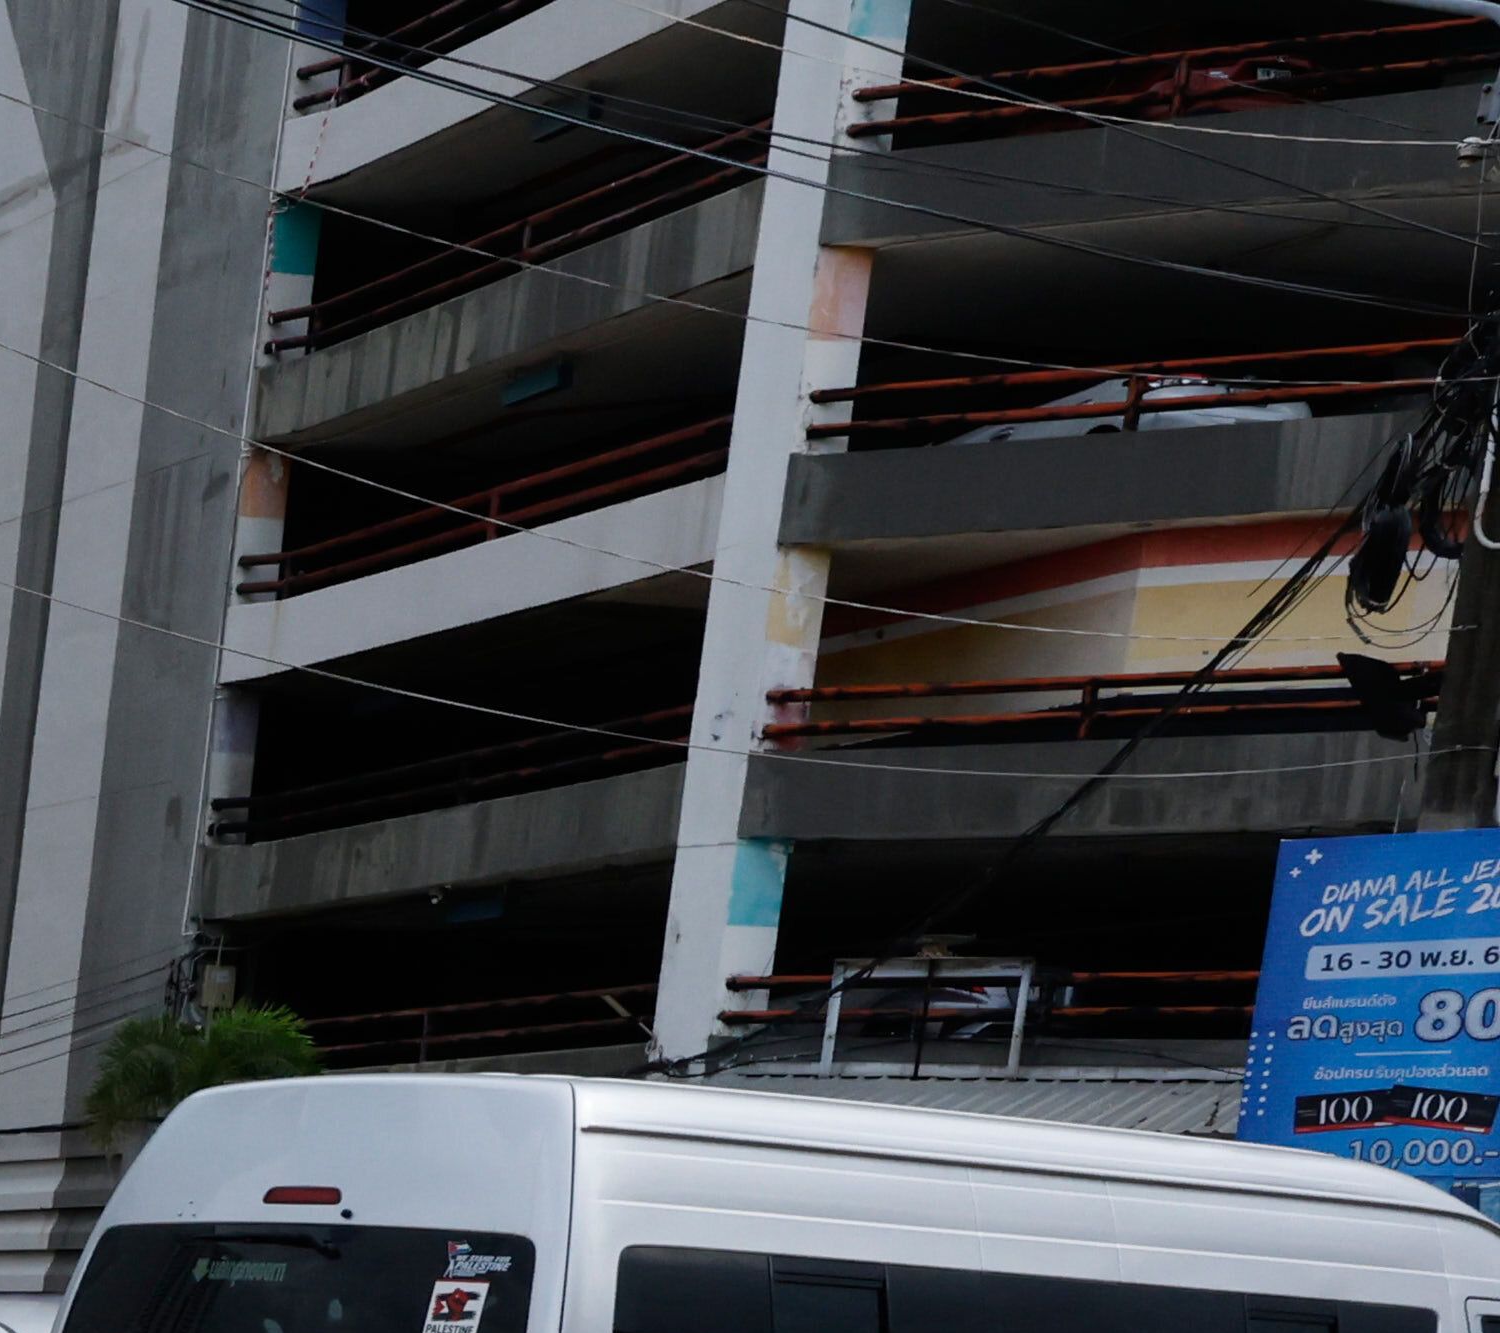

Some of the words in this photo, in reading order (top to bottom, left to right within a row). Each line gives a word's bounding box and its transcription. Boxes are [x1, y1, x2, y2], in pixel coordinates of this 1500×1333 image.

[1322, 874, 1396, 905] DIANA
[1404, 867, 1455, 891] ALL
[1299, 905, 1355, 938] ON
[1362, 887, 1461, 930] SALE
[1320, 952, 1353, 972] 16
[1377, 949, 1412, 970] 30
[1419, 949, 1474, 968] พ.ย.
[1319, 1095, 1374, 1125] 100
[1410, 1091, 1469, 1123] 100
[454, 1261, 512, 1273] PALESTINE
